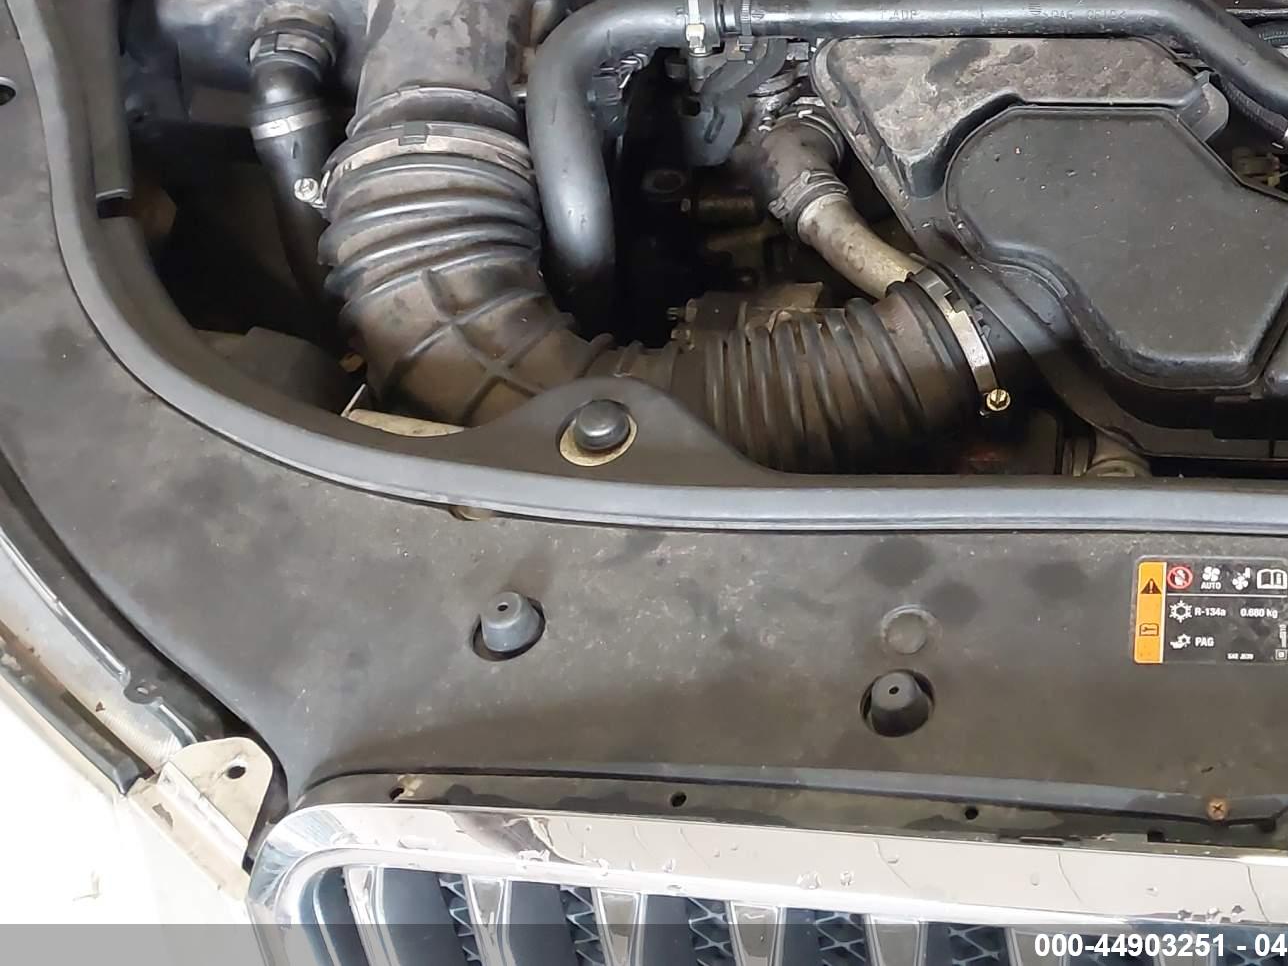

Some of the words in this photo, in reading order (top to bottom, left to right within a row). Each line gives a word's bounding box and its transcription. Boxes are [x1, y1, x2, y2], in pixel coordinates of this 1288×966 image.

[1201, 581, 1222, 590] AUTO
[1194, 607, 1227, 617] R-134a
[1266, 608, 1278, 619] kg
[1195, 637, 1214, 647] PAG
